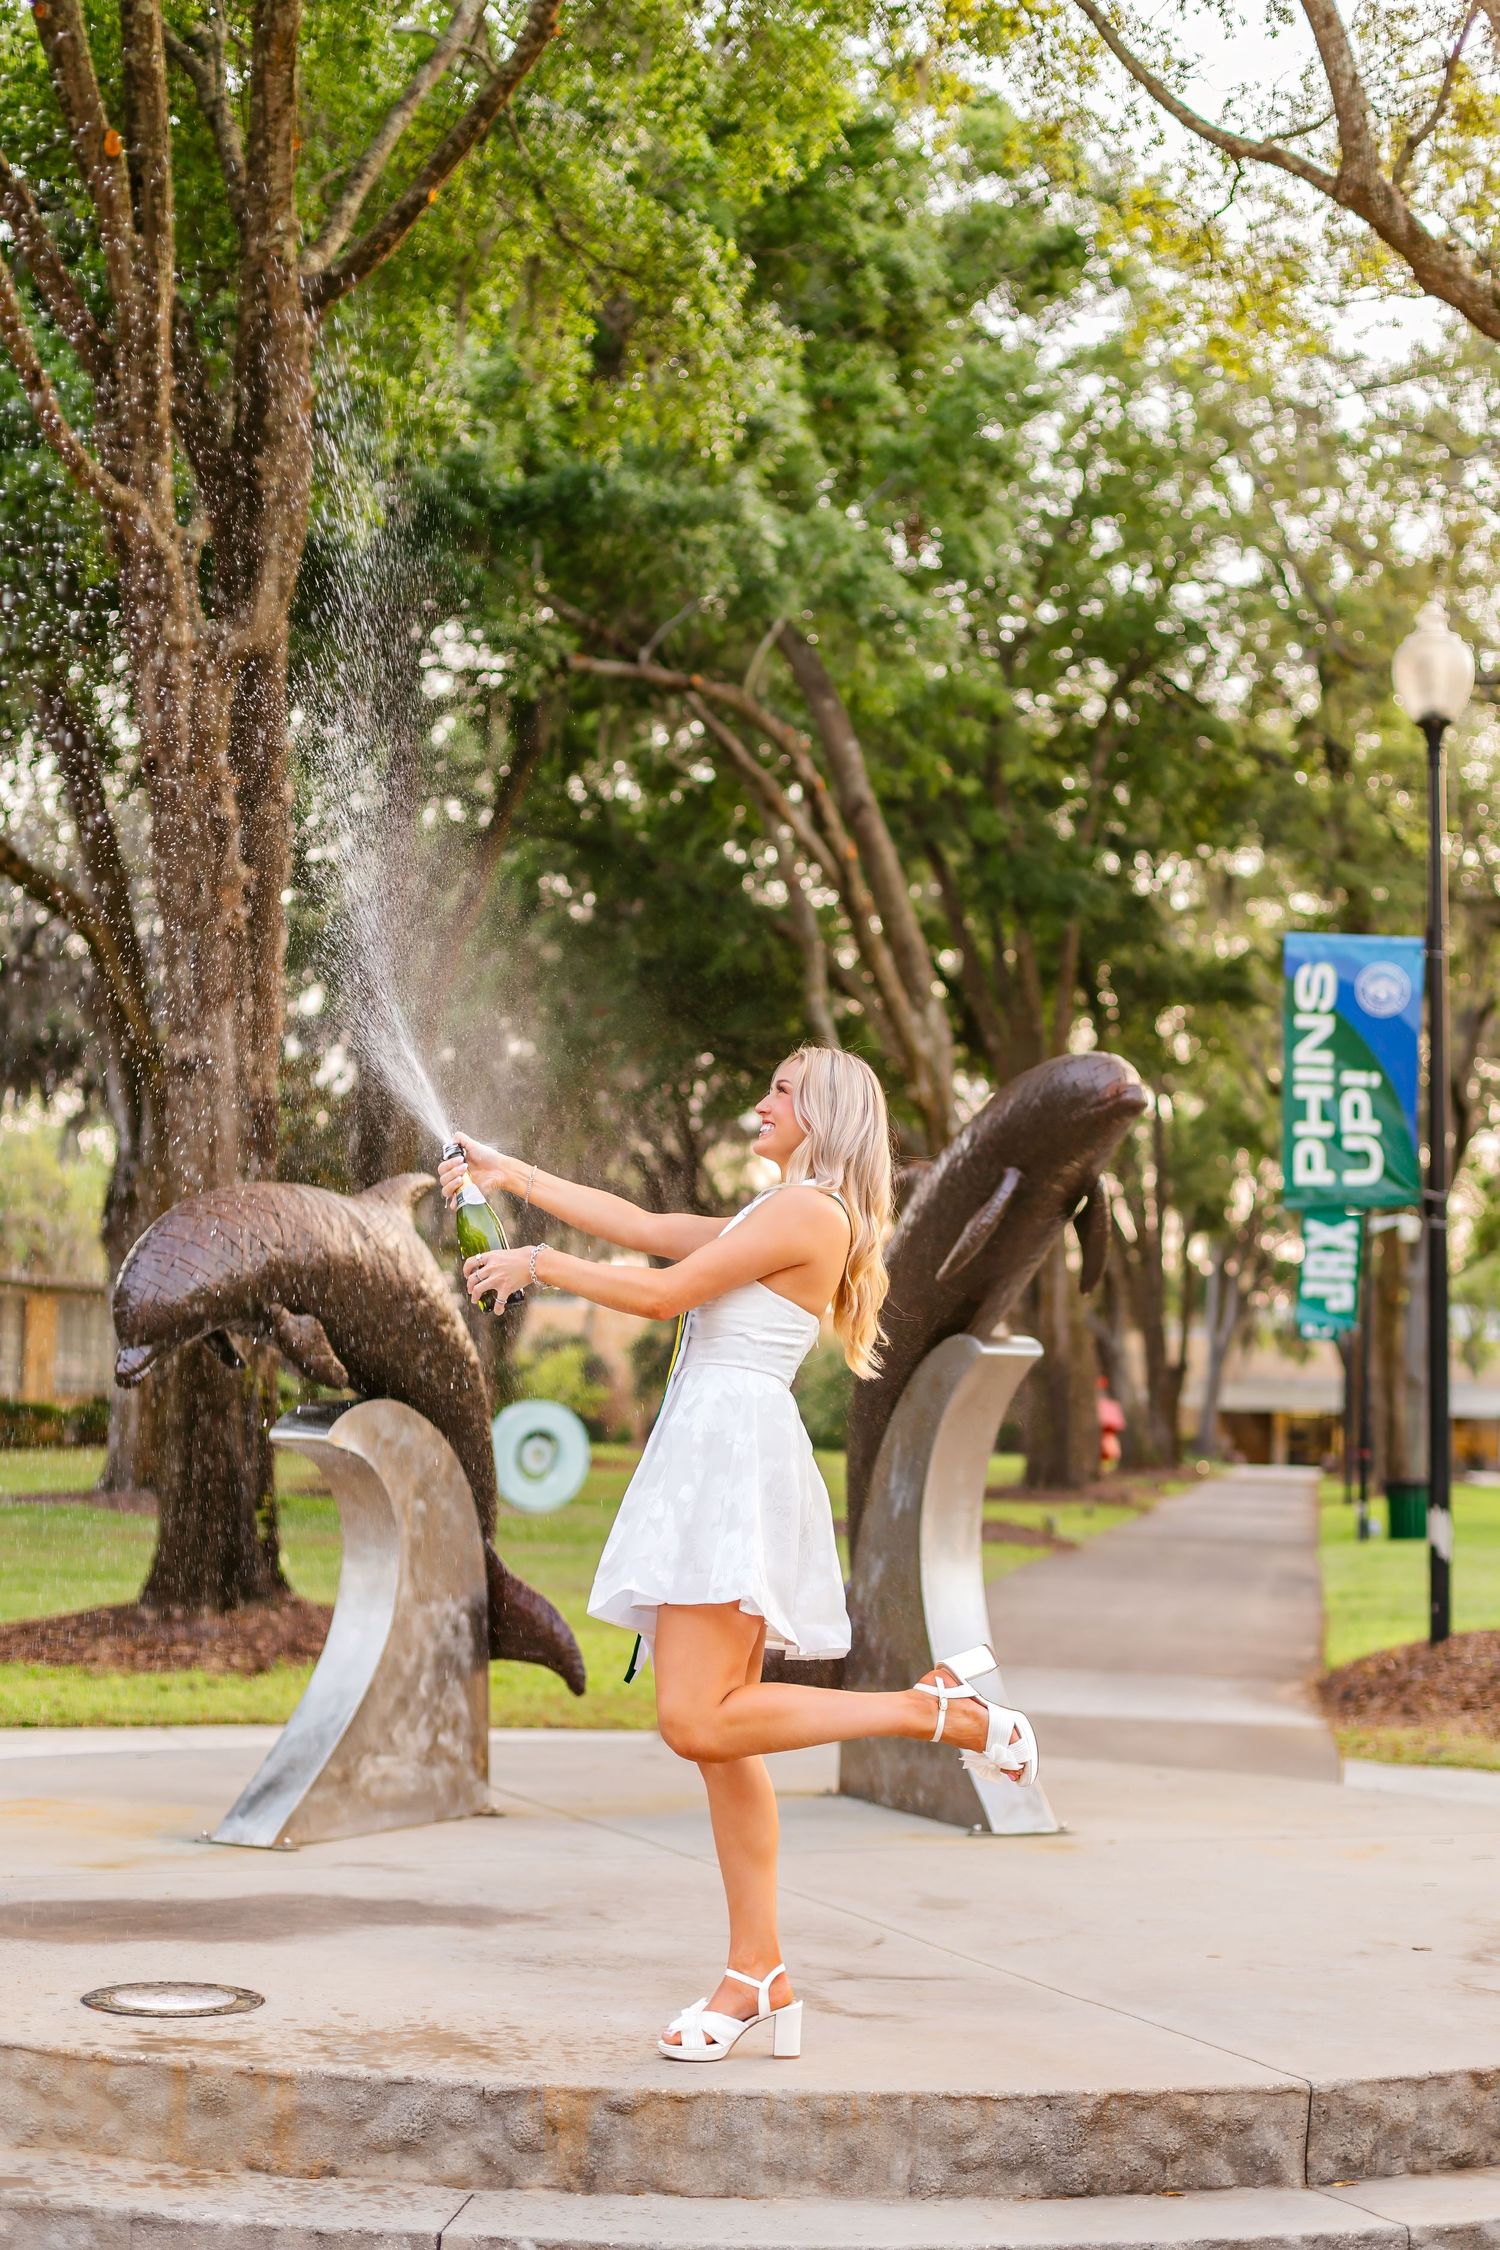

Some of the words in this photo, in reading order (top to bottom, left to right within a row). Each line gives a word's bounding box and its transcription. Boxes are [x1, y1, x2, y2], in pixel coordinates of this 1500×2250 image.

[1292, 961, 1338, 1187] PHINS
[1339, 1070, 1384, 1187] UP!
[1301, 1218, 1359, 1313] JAX
